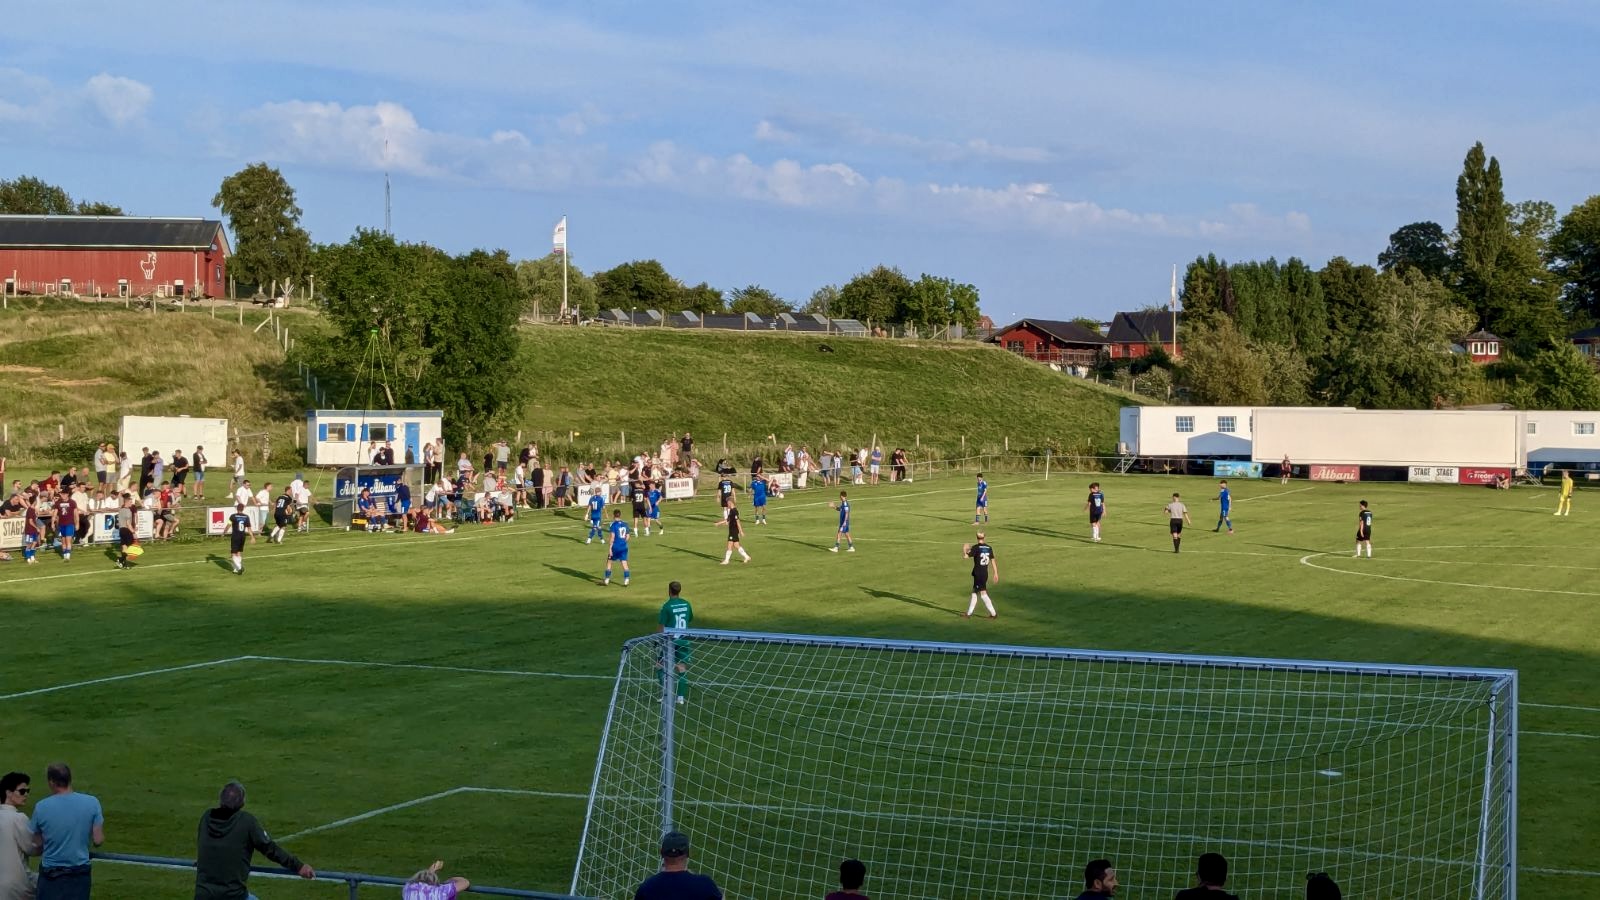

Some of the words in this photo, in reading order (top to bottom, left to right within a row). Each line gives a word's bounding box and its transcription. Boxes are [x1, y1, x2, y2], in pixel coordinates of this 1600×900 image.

[1313, 466, 1356, 480] Albani
[1413, 467, 1431, 477] STAGE
[1436, 468, 1454, 477] STAGE
[369, 478, 397, 494] Albani
[238, 520, 245, 532] 6
[980, 553, 990, 565] 25
[674, 613, 687, 629] 16
